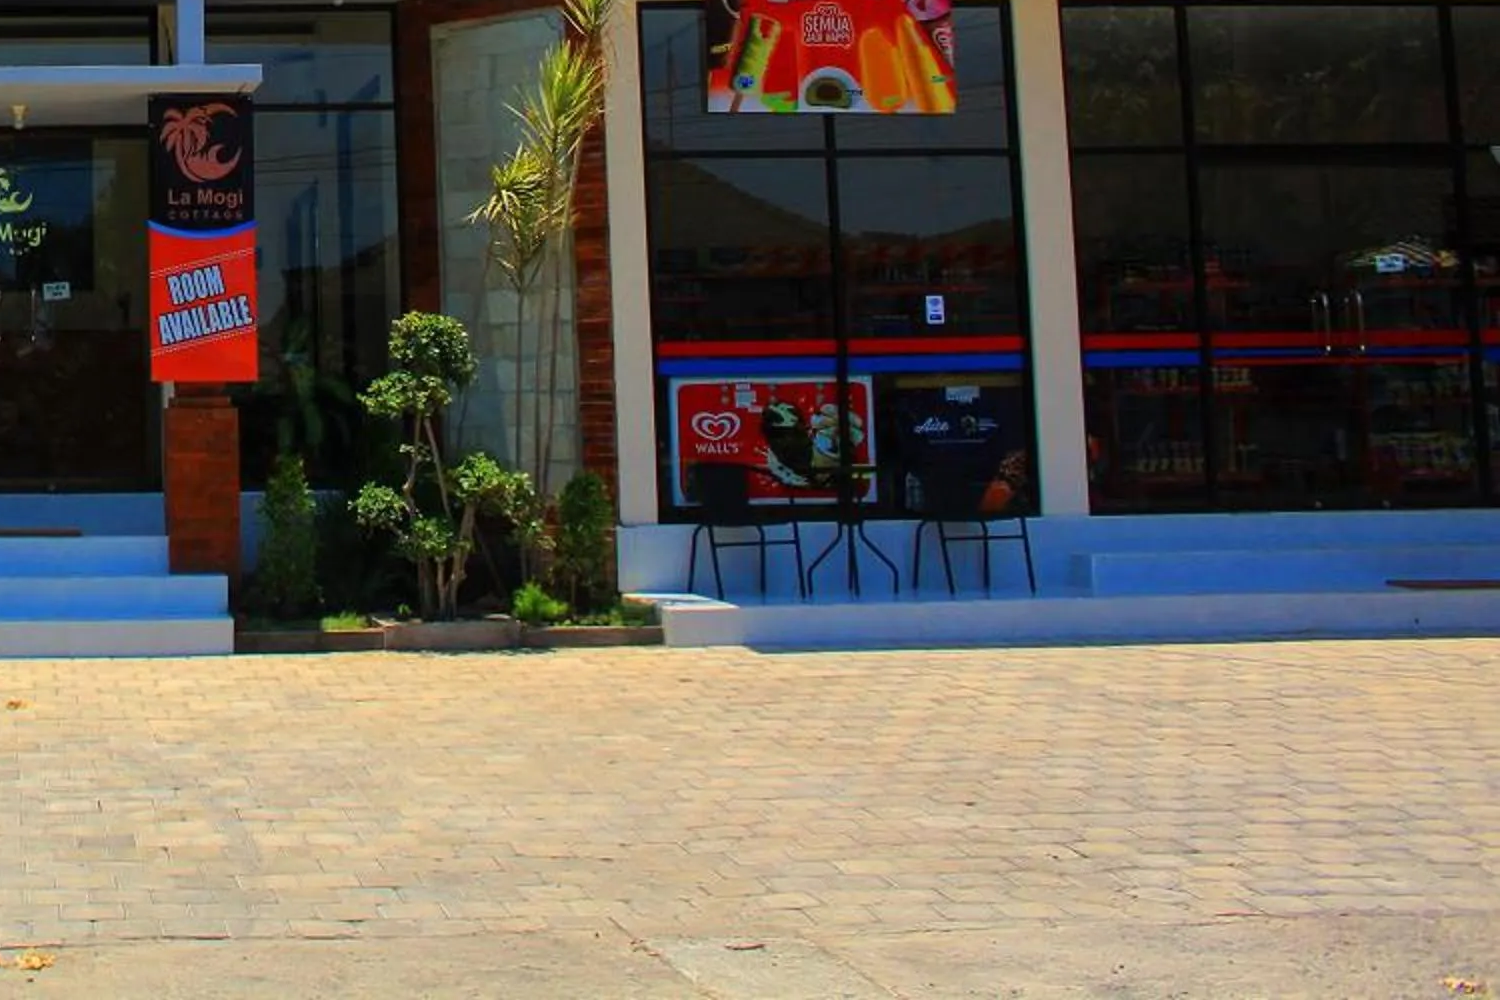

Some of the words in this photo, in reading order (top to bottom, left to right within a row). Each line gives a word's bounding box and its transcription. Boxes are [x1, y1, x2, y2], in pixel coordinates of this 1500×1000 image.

[805, 15, 849, 33] SEMUA
[167, 188, 192, 205] La
[197, 188, 244, 209] Mogi
[168, 210, 244, 220] COTTAGE
[167, 265, 225, 305] ROOM
[158, 296, 253, 346] AVAILABLE
